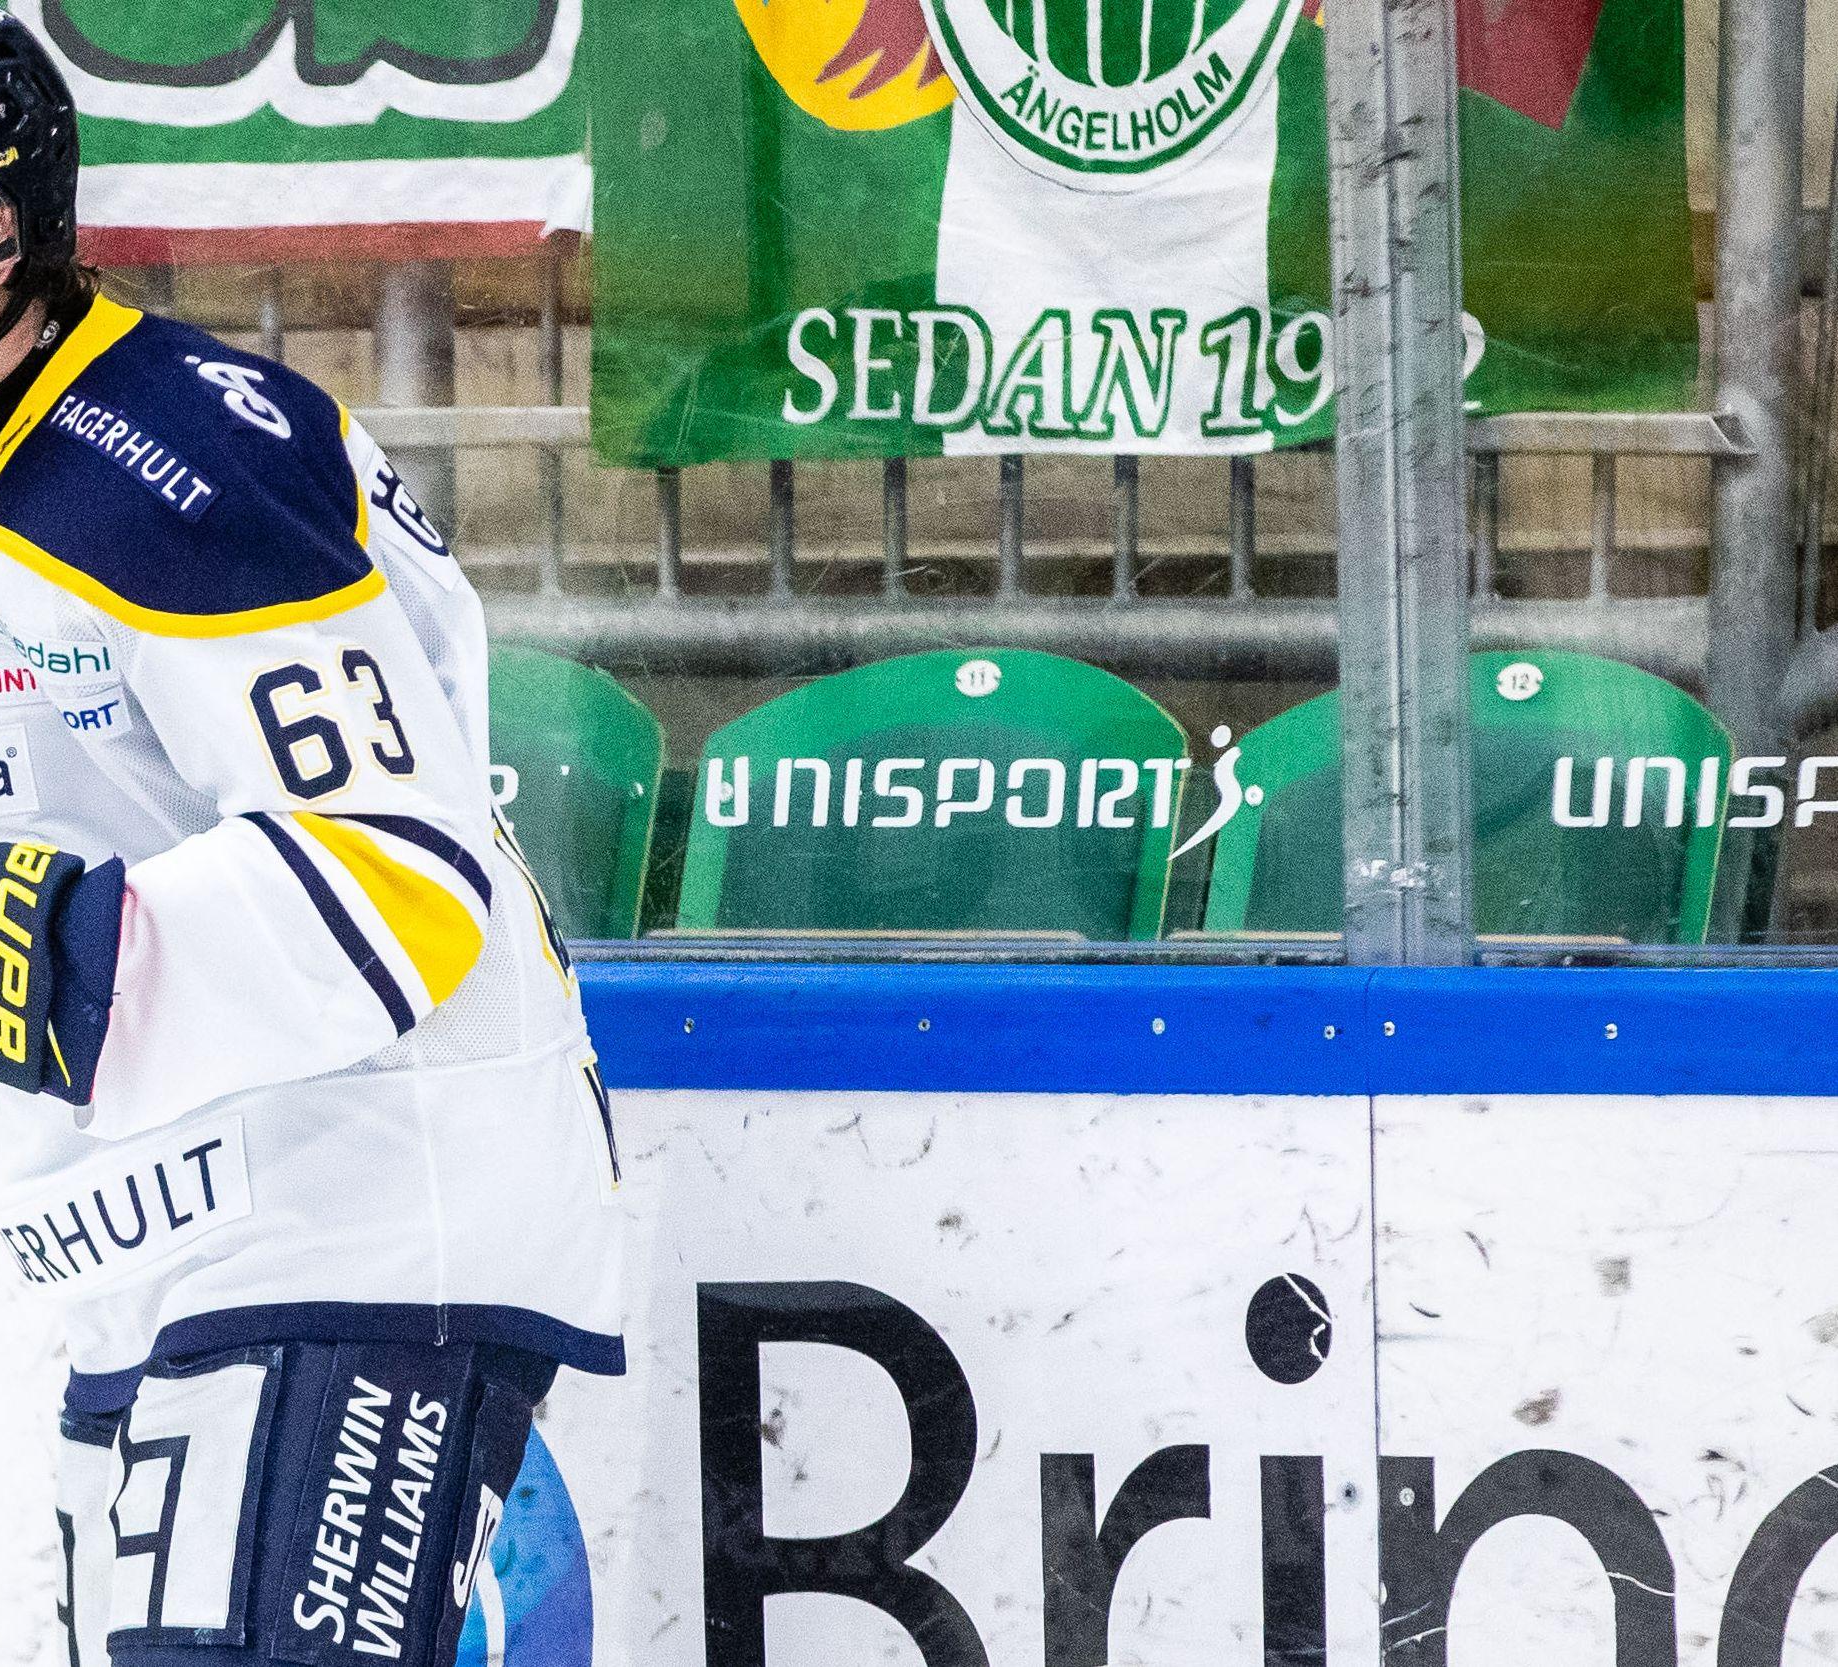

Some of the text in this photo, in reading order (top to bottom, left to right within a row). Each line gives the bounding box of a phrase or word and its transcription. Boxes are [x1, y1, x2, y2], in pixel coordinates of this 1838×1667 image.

[1000, 51, 1233, 151] ÄNGELHOLM
[783, 306, 1186, 440] SEDAN
[50, 395, 212, 511] FAGERHULT
[246, 645, 420, 803] 63
[706, 756, 1191, 829] UNISPORT
[293, 1375, 393, 1645] SHERWIN
[352, 1390, 448, 1659] WILLIAMS
